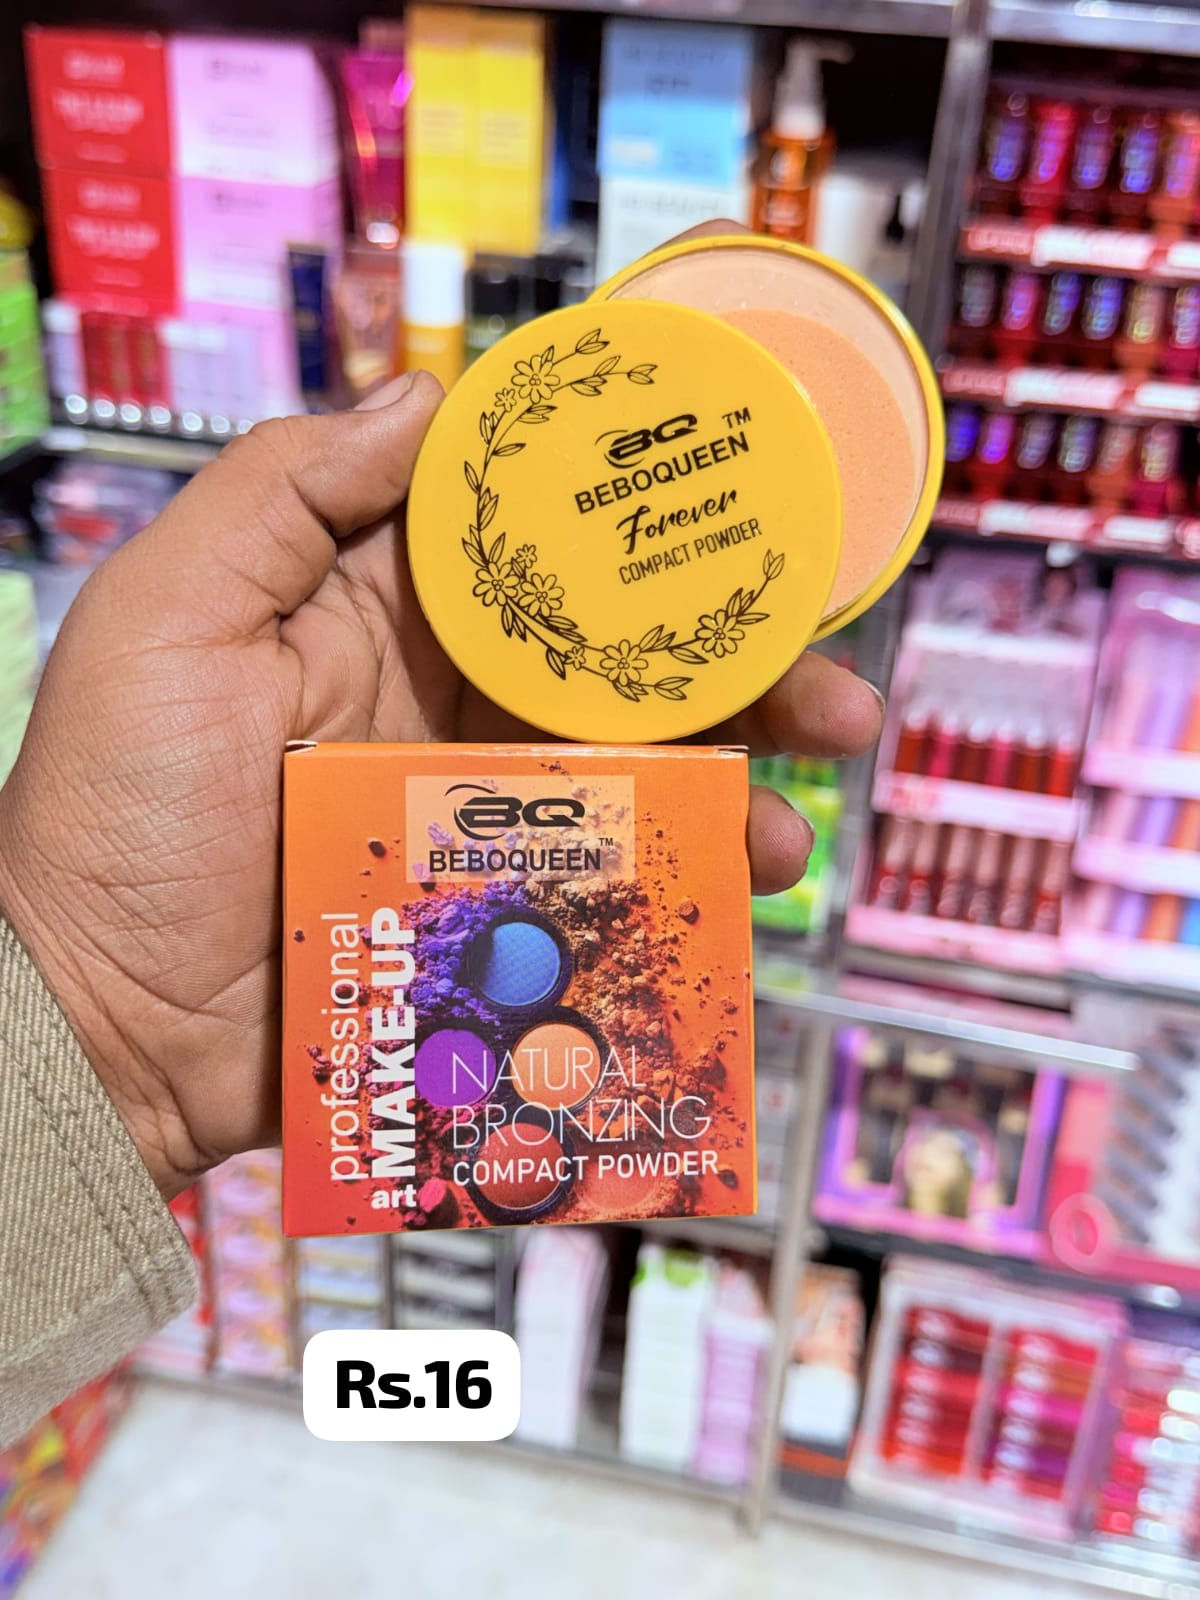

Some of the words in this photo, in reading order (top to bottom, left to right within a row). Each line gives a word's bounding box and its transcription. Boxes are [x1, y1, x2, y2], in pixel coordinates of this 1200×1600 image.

[602, 413, 698, 466] BQ
[574, 431, 749, 514] BEBOQUEEN
[616, 489, 737, 555] Forever
[618, 543, 692, 585] COMPACT
[694, 518, 762, 558] POWDER
[454, 797, 585, 841] BQ
[429, 848, 601, 873] BEBOQUEEN
[321, 913, 369, 1181] professional
[371, 907, 416, 1178] MAKE-UP
[452, 1045, 647, 1094] NATURAL
[452, 1095, 711, 1149] BRONZING
[452, 1156, 589, 1186] COMPACT
[598, 1150, 719, 1179] POWDER
[371, 1184, 417, 1210] art
